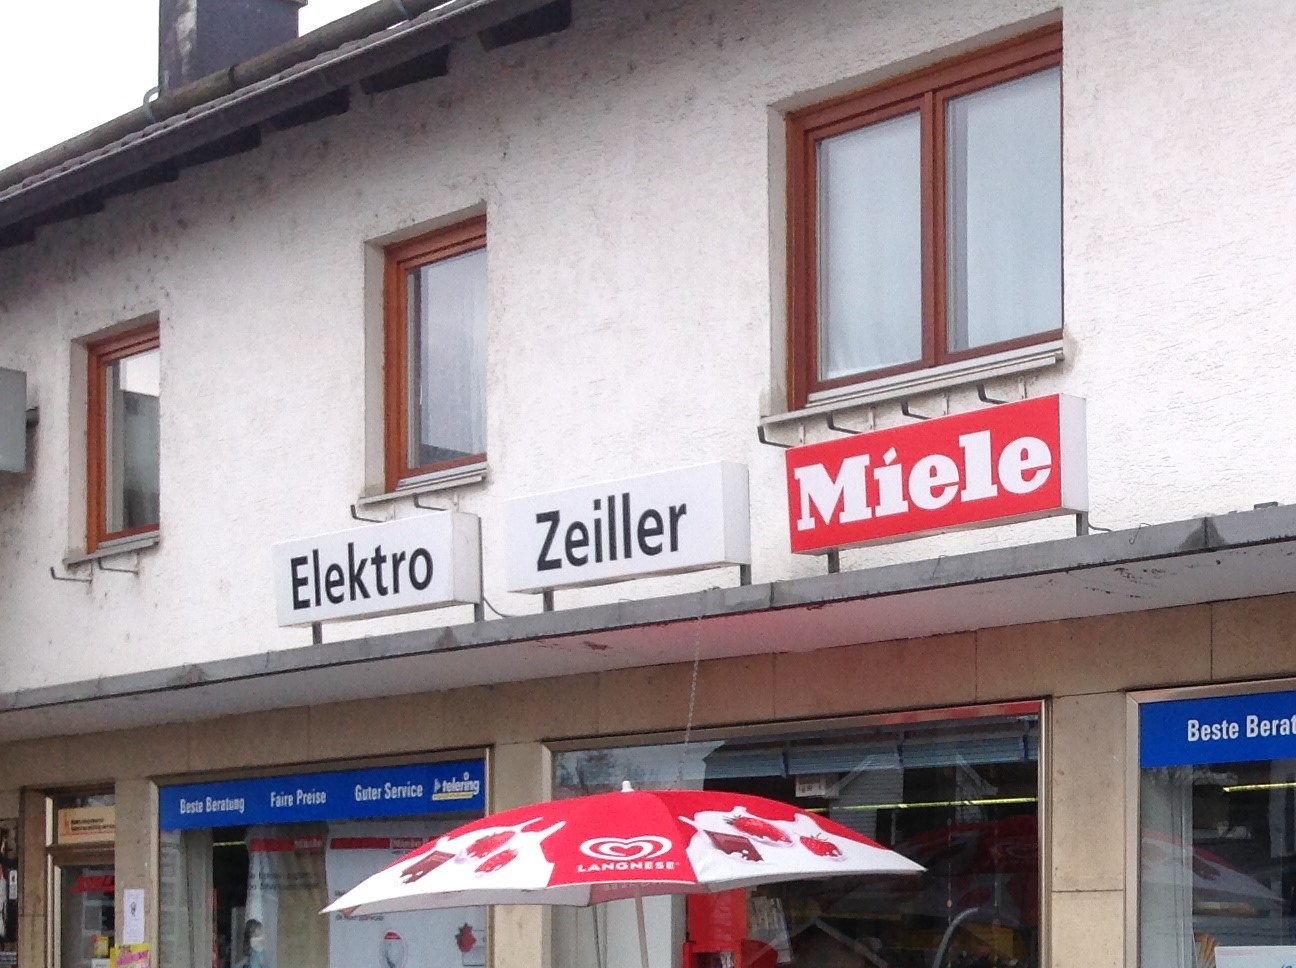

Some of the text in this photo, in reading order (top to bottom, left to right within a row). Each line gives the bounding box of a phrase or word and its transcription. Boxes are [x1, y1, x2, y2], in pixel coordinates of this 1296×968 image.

[796, 430, 1053, 530] Miele
[536, 492, 688, 571] Zeiller
[290, 540, 434, 611] Elektro
[1187, 716, 1241, 742] Beste
[355, 784, 382, 802] Guter
[384, 781, 423, 799] Service
[443, 772, 480, 796] telering
[180, 796, 245, 814] Beste Beratung
[270, 789, 327, 807] Faire Preise
[577, 861, 675, 873] LANGNESE
